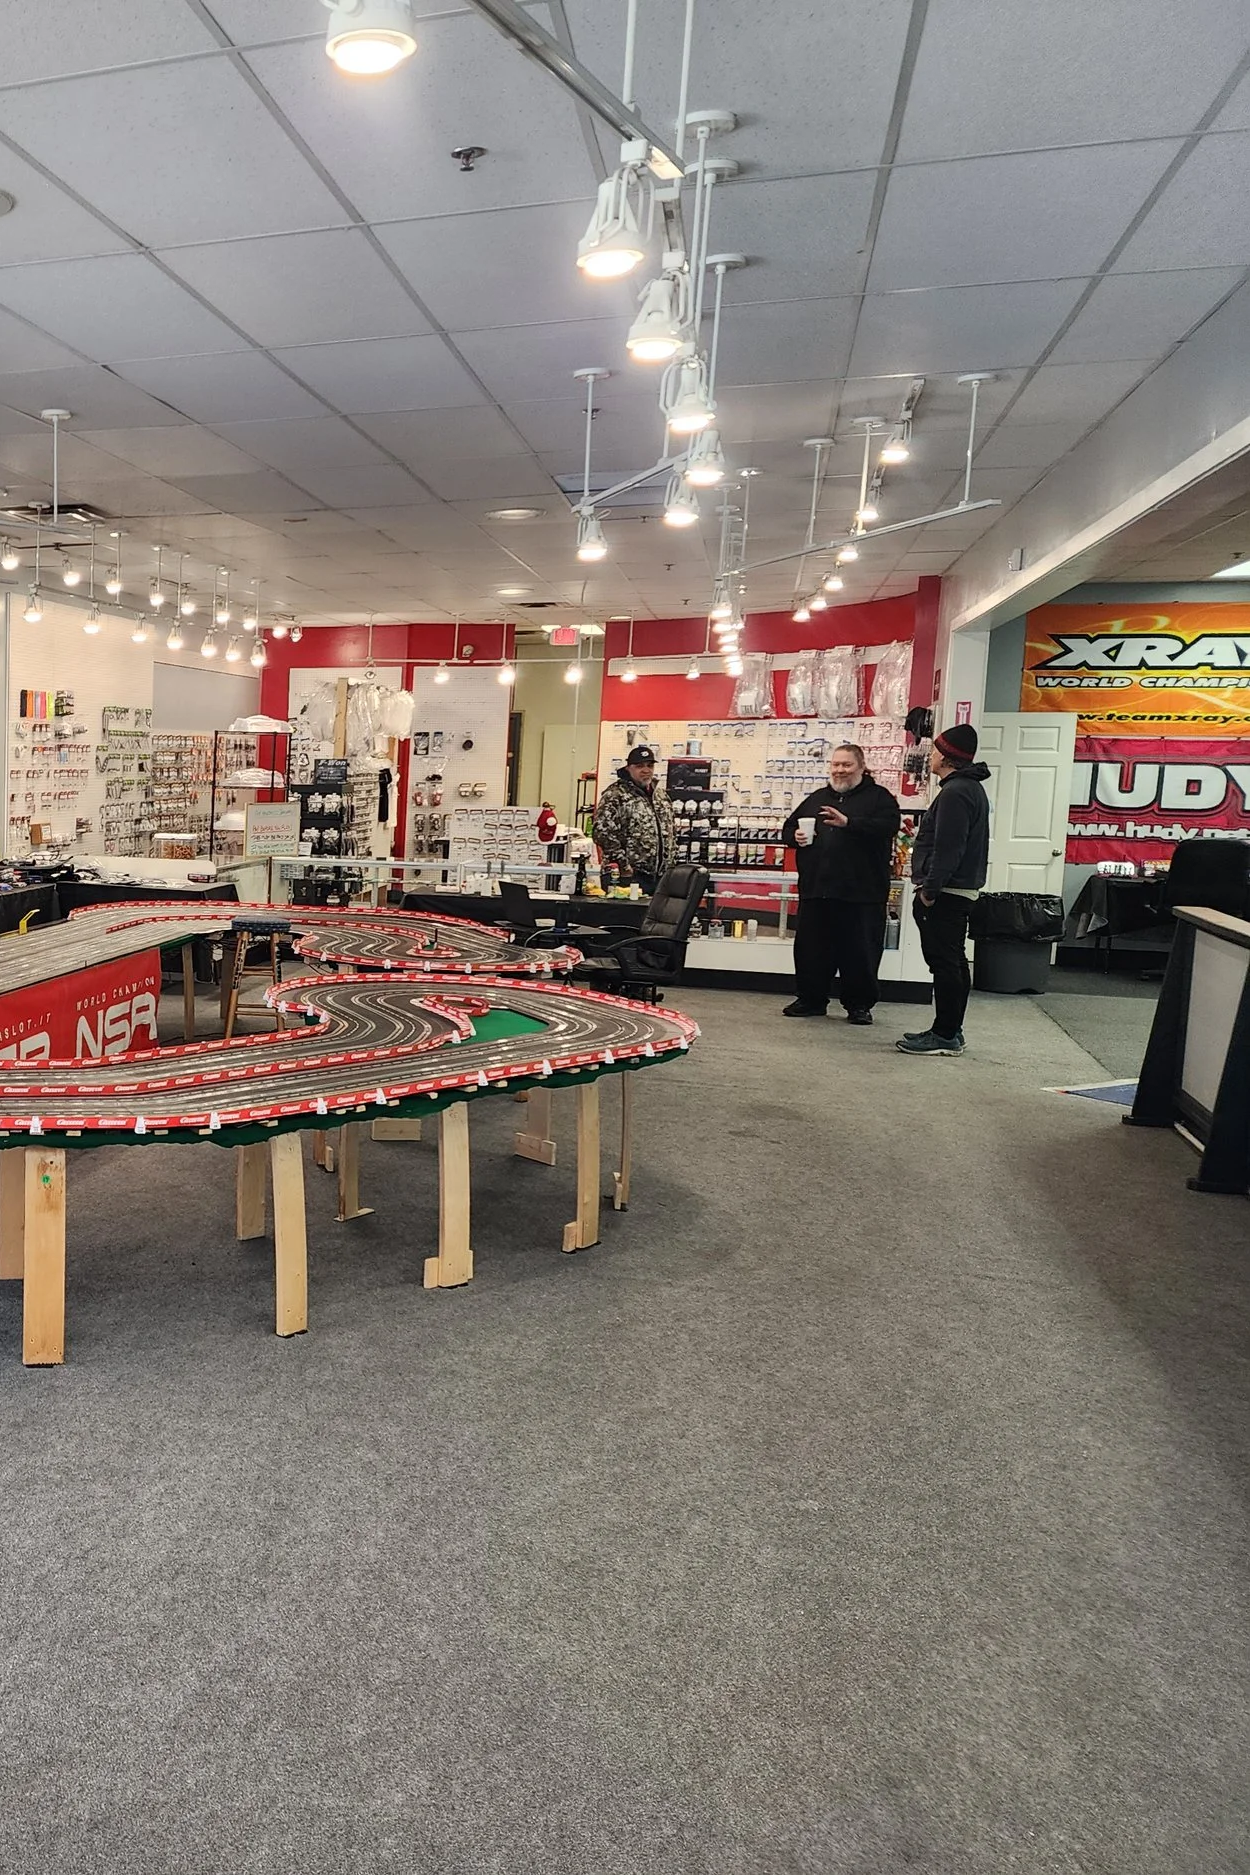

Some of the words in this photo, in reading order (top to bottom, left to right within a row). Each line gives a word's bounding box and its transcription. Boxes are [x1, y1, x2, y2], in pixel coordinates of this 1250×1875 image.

[1036, 676, 1132, 688] WORLD
[1139, 676, 1250, 688] CHAMPI
[76, 993, 107, 1011] WORLD
